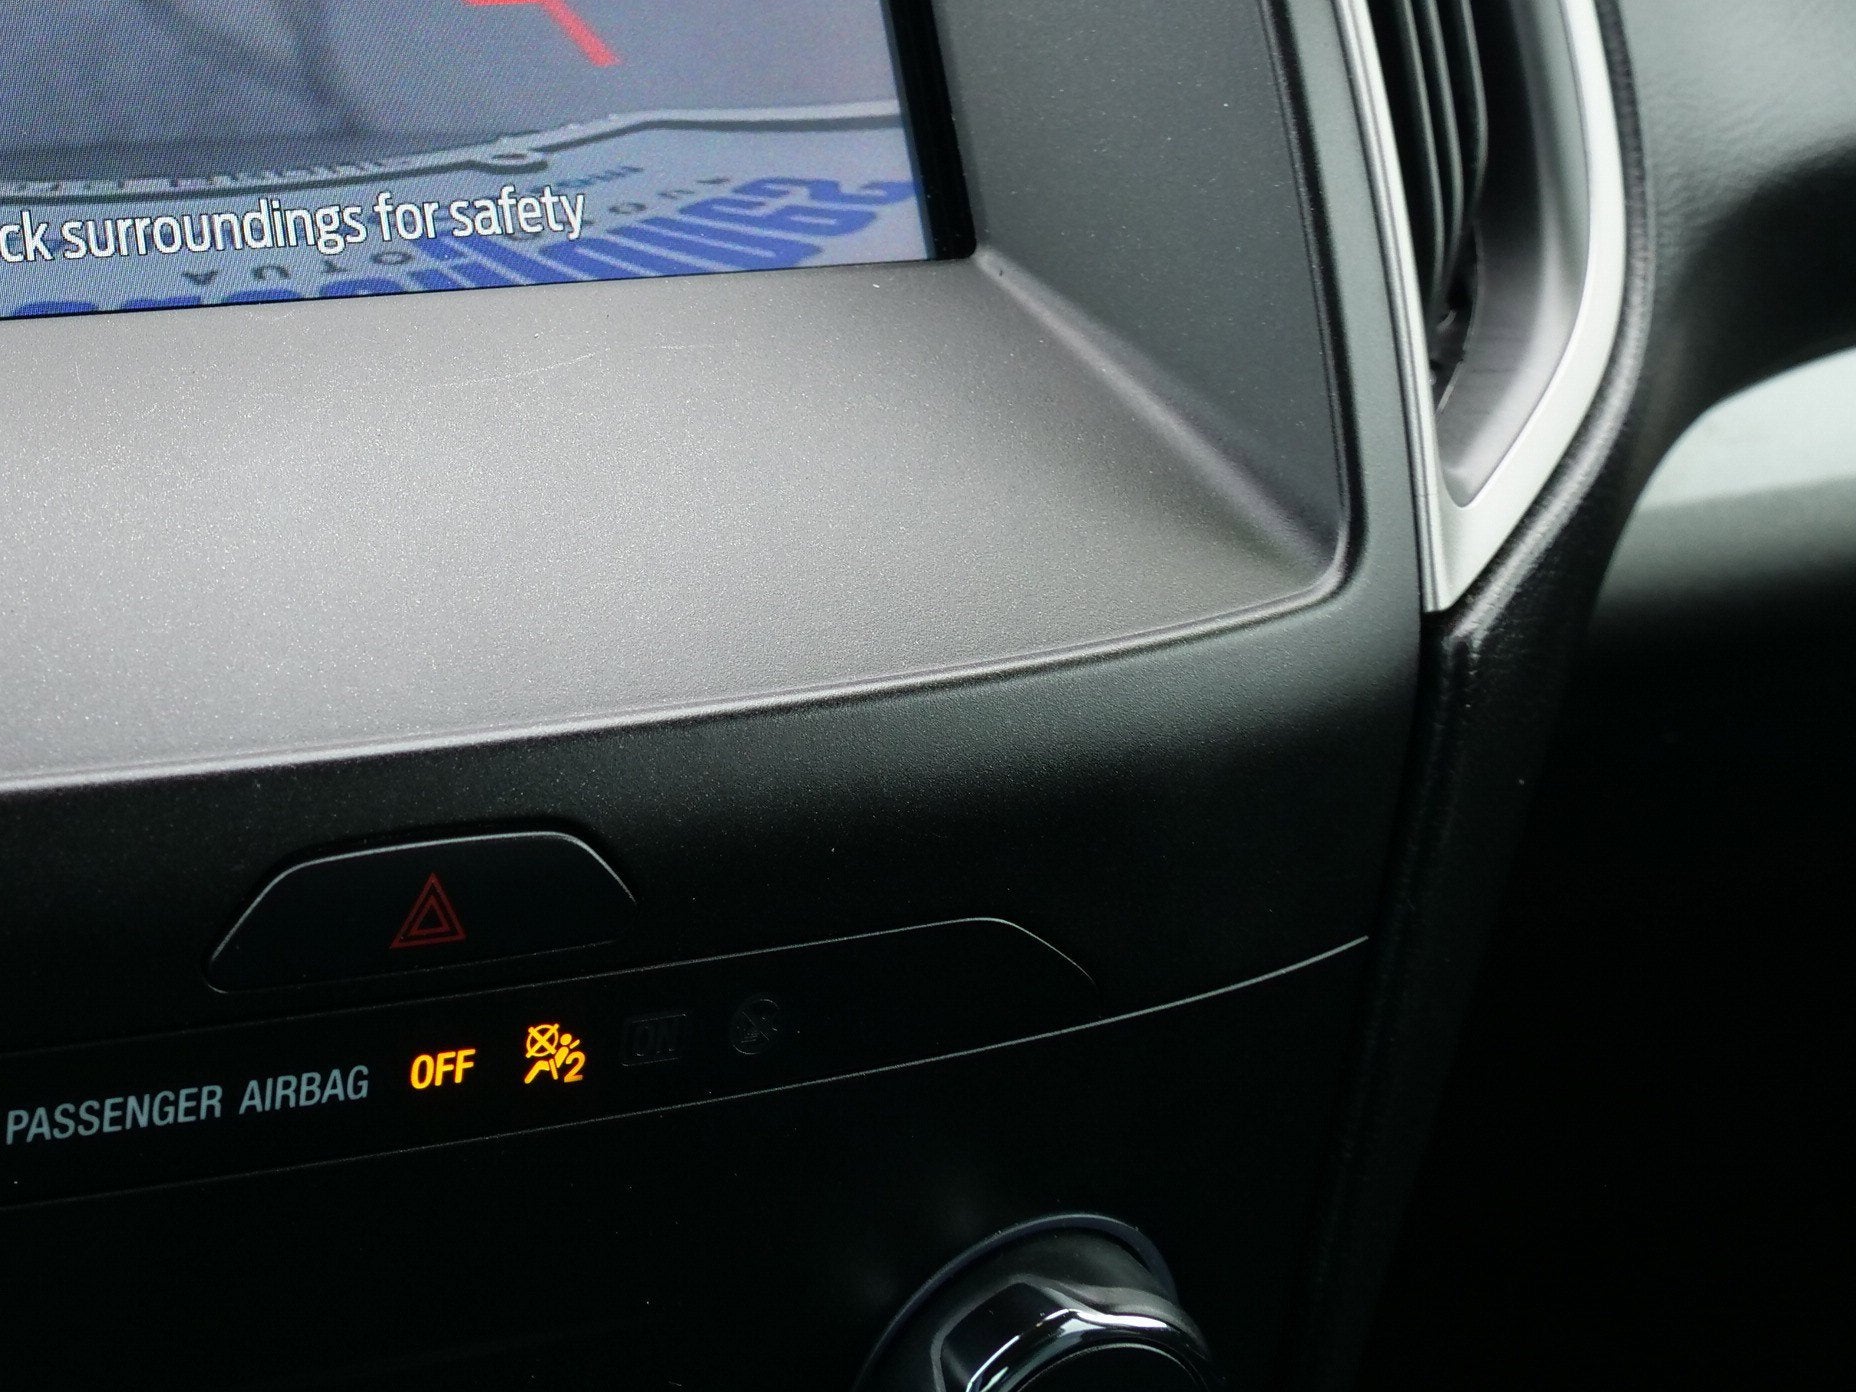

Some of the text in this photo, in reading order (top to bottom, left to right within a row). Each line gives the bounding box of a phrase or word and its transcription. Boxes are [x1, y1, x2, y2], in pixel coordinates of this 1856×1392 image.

[59, 197, 369, 262] surroundings
[372, 190, 440, 243] for
[448, 184, 586, 241] safety
[5, 1047, 478, 1146] PASSENGER AIRBAG OFF
